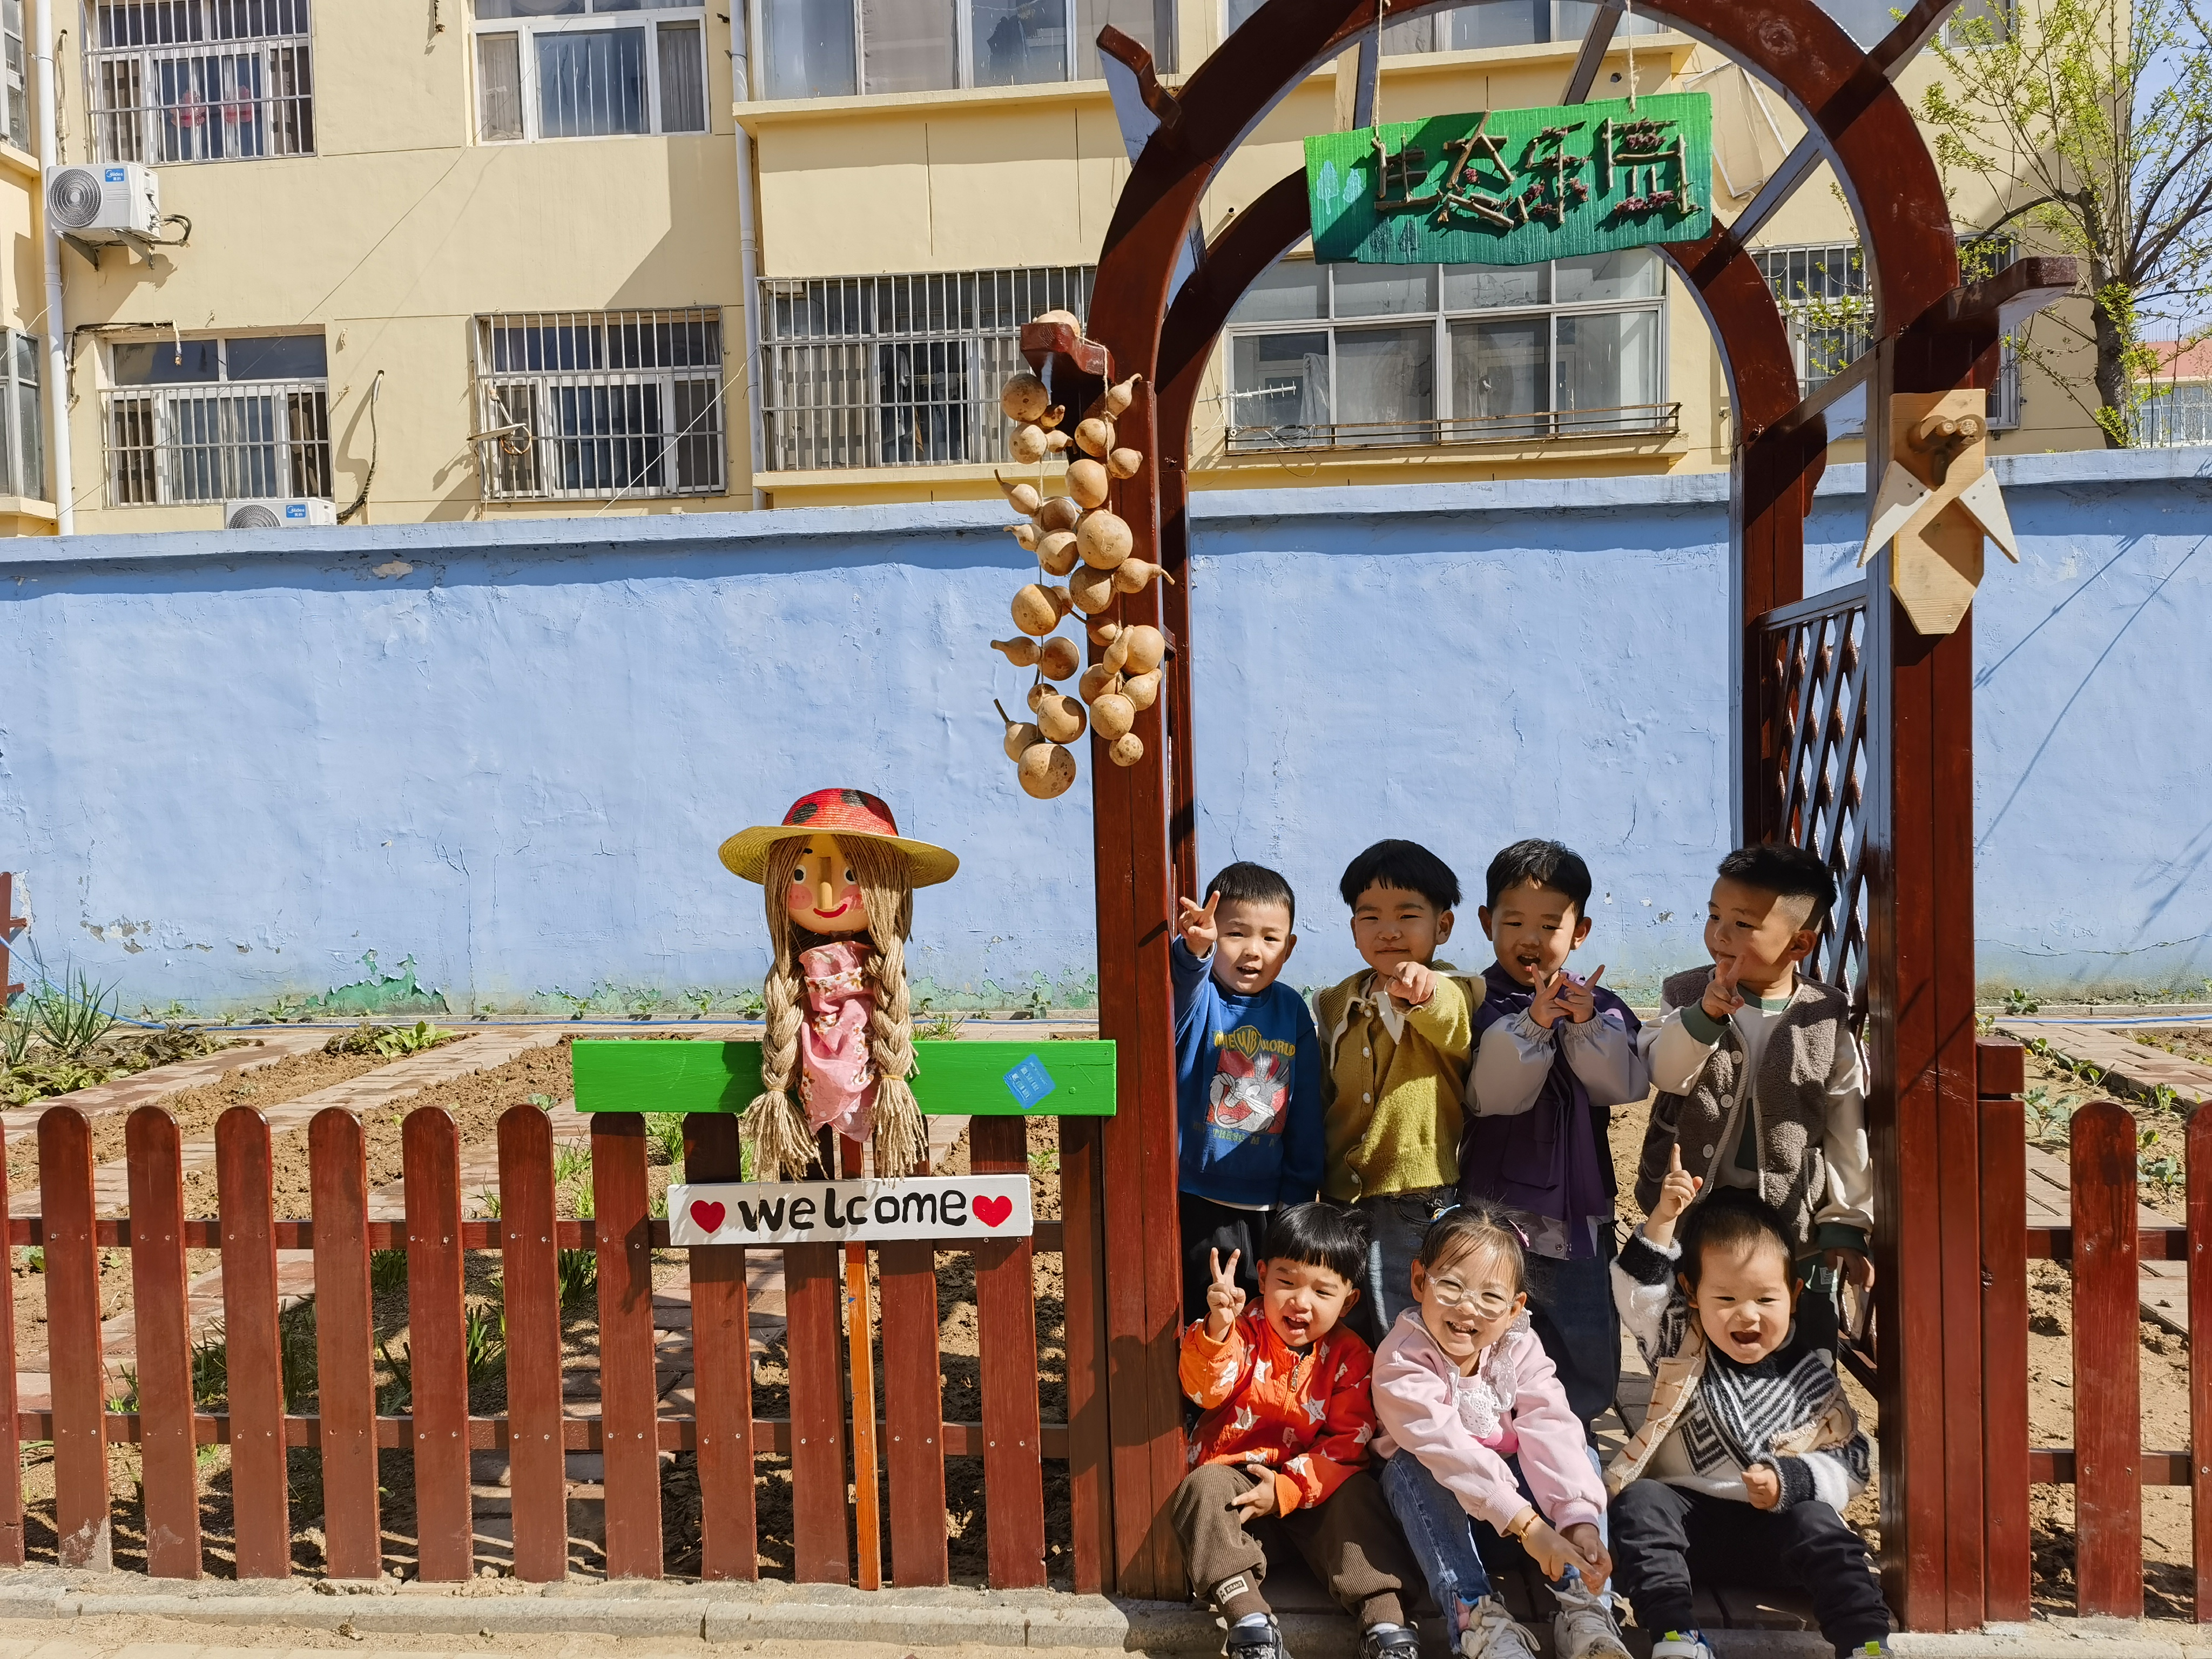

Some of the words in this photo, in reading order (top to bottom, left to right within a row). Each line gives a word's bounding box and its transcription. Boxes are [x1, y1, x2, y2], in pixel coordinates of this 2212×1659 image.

[1237, 1029, 1257, 1055] WB
[1260, 1037, 1296, 1056] WORLD
[738, 1188, 967, 1232] welcome
